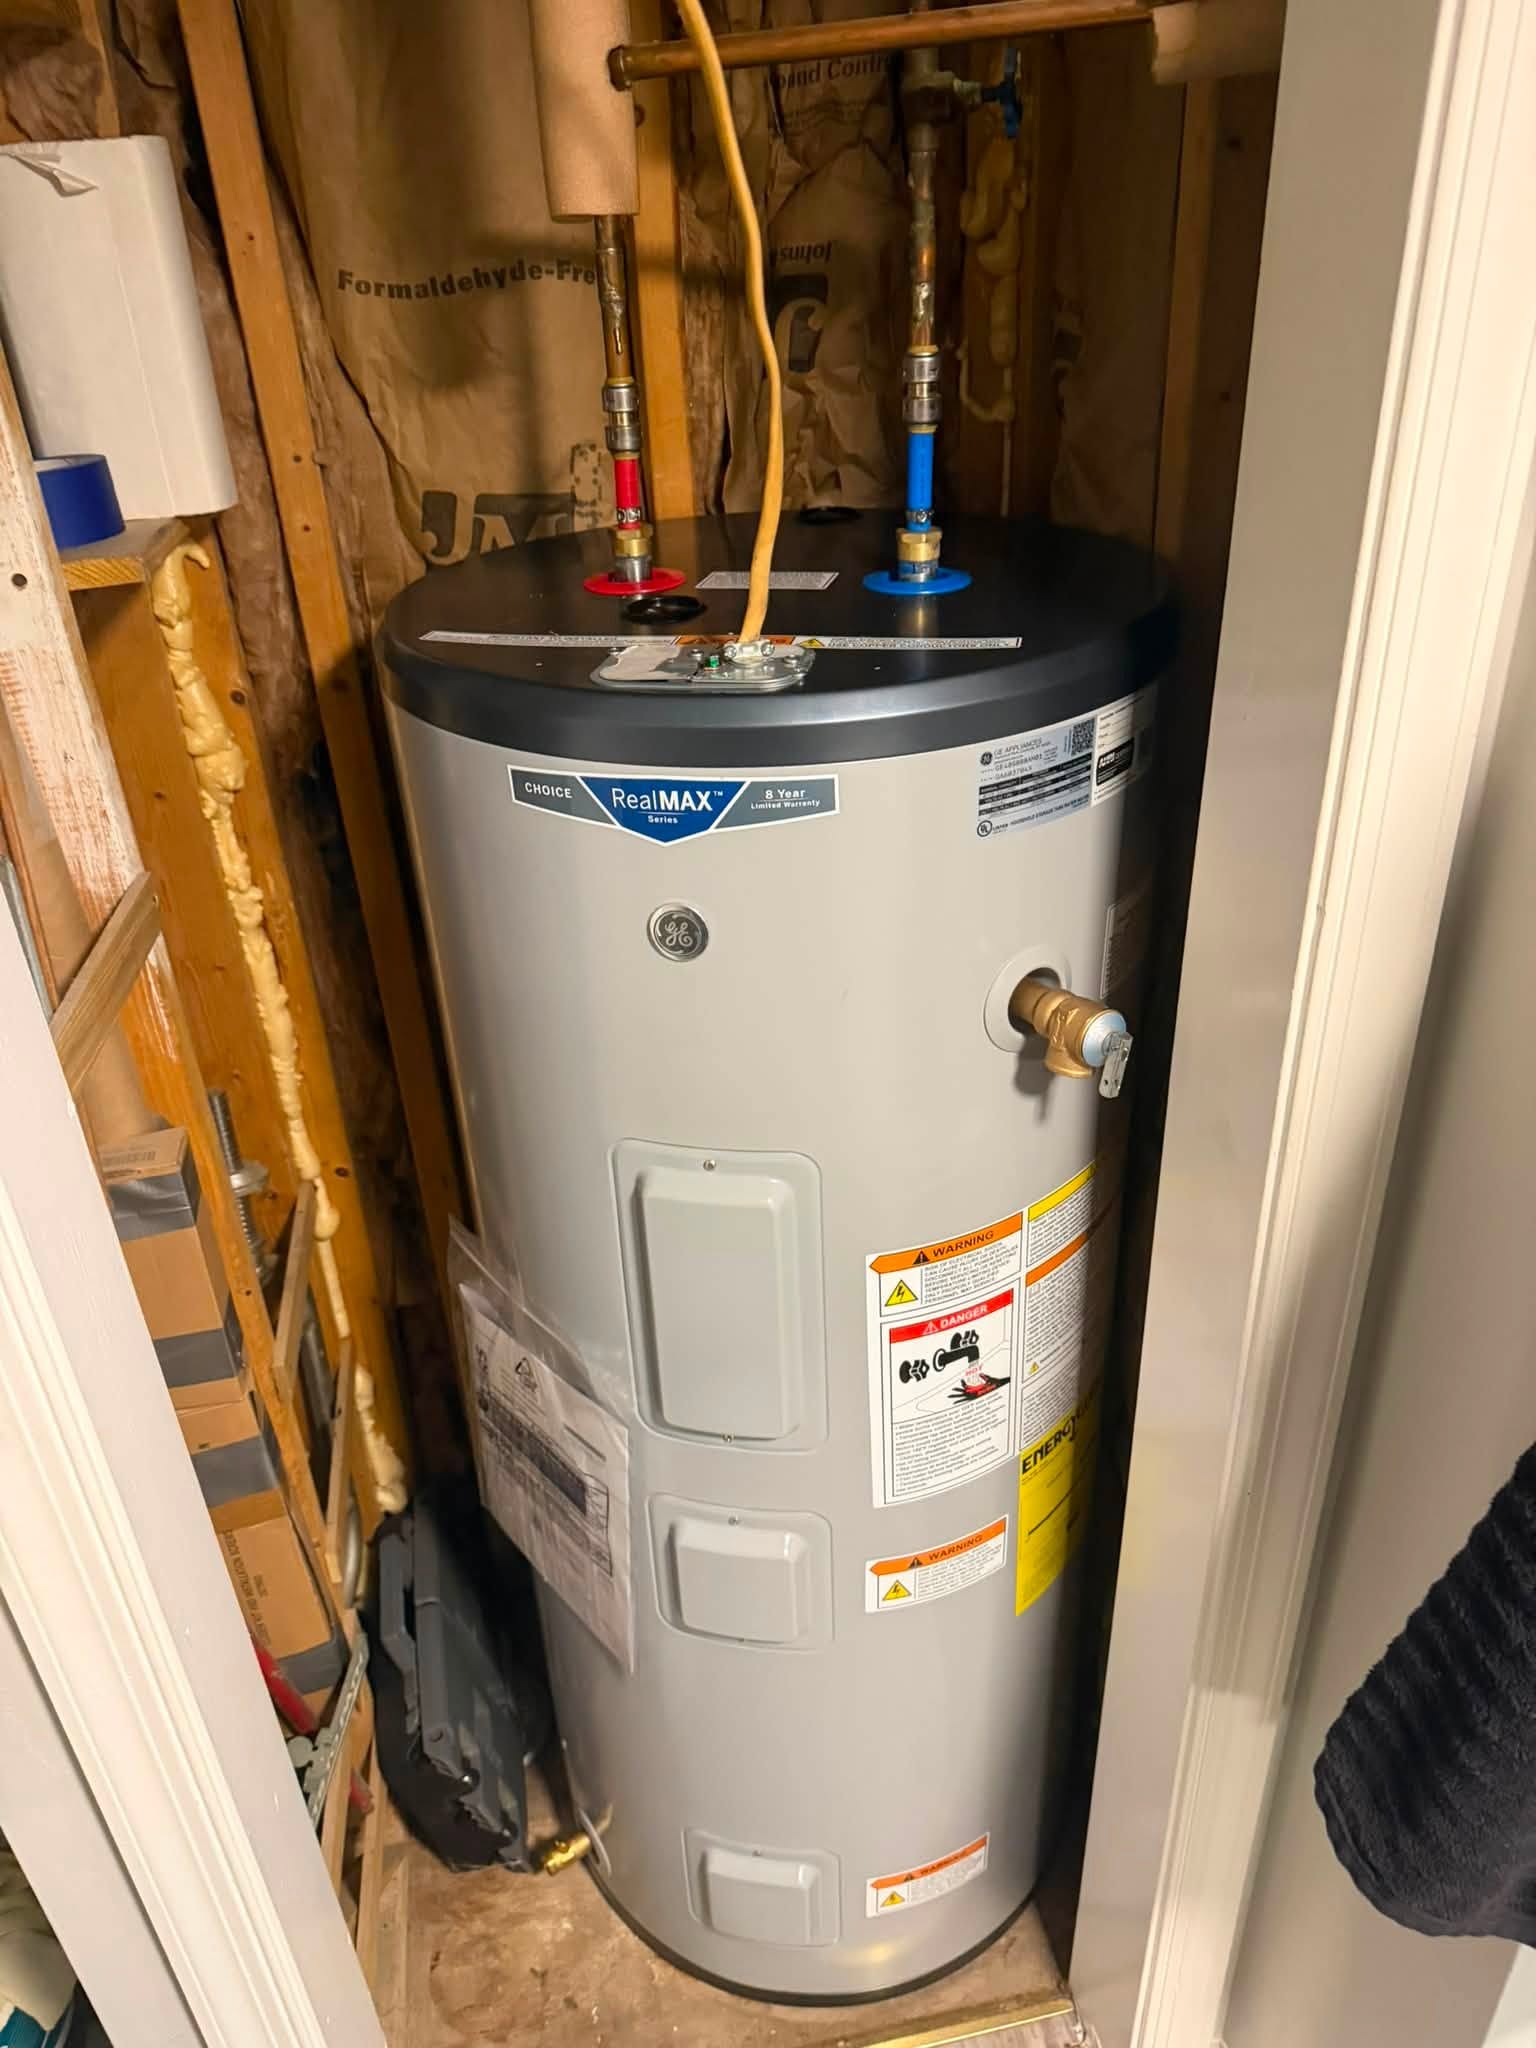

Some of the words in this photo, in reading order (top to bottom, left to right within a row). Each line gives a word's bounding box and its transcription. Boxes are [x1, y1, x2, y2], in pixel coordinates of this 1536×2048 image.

[337, 258, 600, 300] Formaldehyde-Fre
[524, 782, 573, 799] CHOICE
[765, 789, 774, 800] 8
[777, 789, 806, 799] Year
[750, 801, 782, 810] Limited
[783, 799, 820, 809] Warranty
[647, 815, 679, 824] Series
[932, 1231, 995, 1257] WARNING
[940, 1304, 988, 1329] DANGER
[928, 1534, 983, 1562] WARNING
